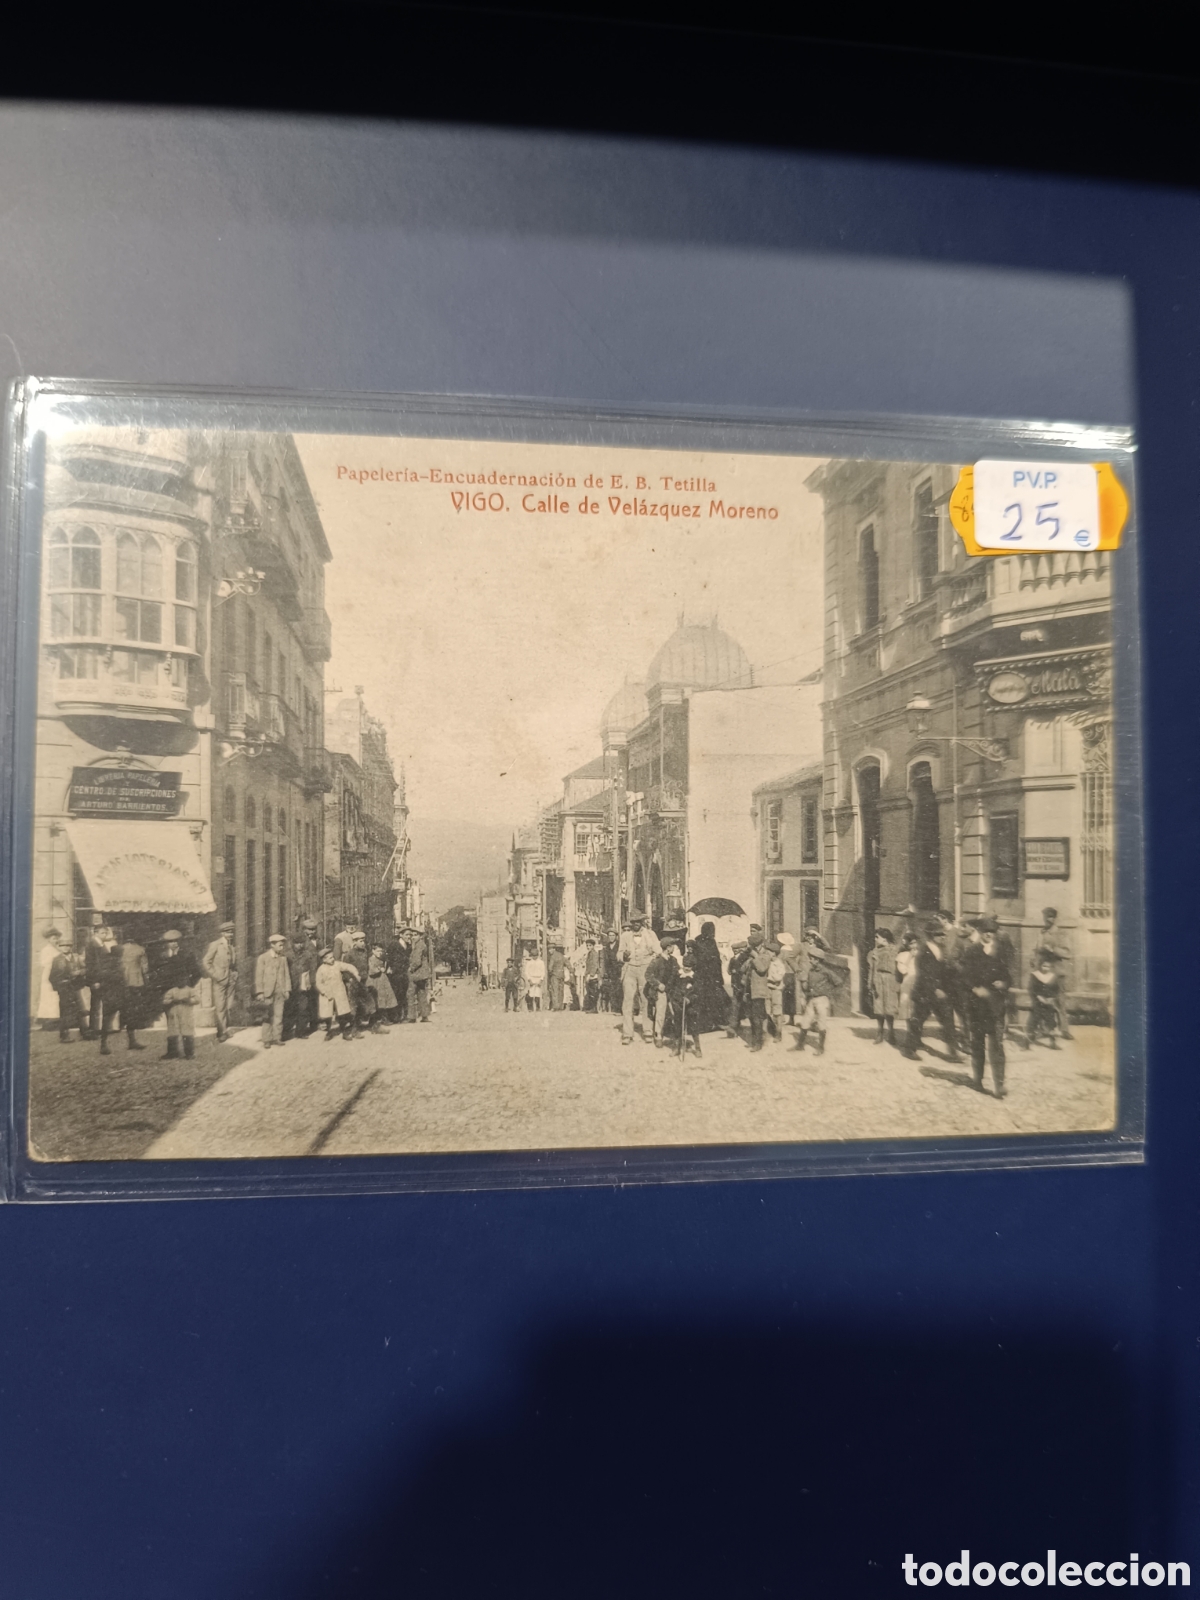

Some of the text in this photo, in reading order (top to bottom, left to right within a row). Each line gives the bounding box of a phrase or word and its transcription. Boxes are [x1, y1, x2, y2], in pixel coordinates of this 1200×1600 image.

[336, 465, 717, 492] Papelería-Encuadernación de E. B. Tetilla
[450, 491, 779, 520] VIGO. Calle de Velázquez Moreno
[1000, 501, 1091, 547] 25 €
[74, 785, 176, 798] CENTRO DE SUSCRIPCIONES
[81, 801, 113, 809] ARTURO
